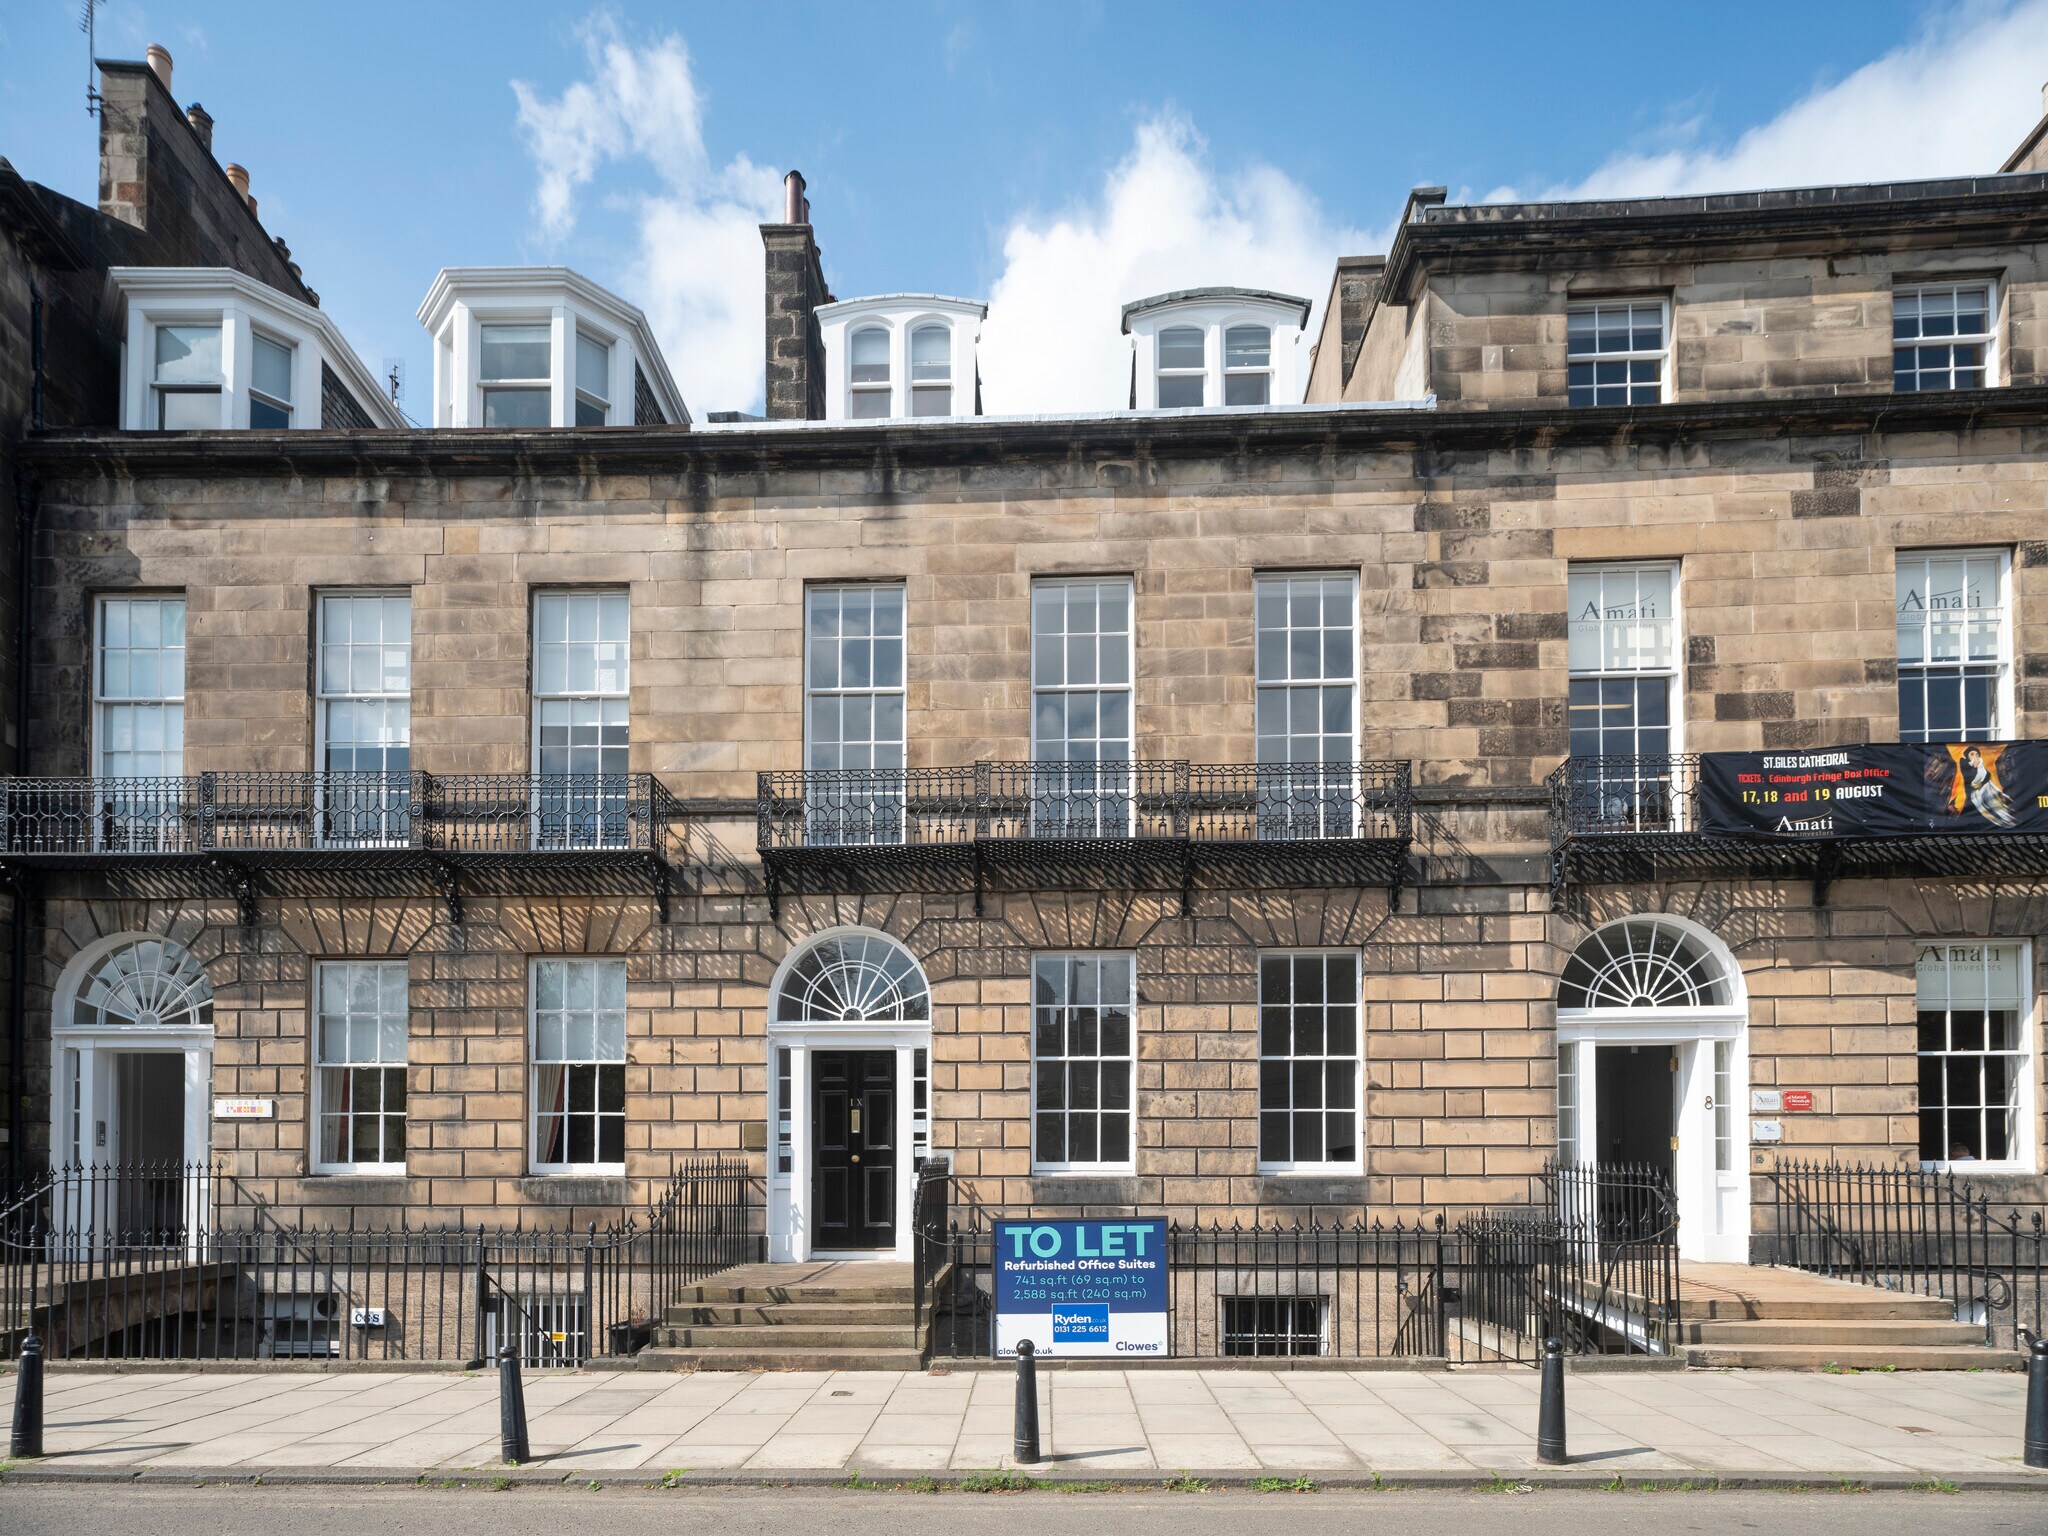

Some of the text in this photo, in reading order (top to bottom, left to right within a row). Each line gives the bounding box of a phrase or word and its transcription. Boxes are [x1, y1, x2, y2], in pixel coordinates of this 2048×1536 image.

[1901, 589, 1981, 610] Amati
[1581, 601, 1655, 620] Amati
[1578, 623, 1609, 632] Globl
[1799, 752, 1850, 768] CATHEDRAL
[1769, 773, 1812, 784] Edinburgh
[1813, 771, 1842, 782] Fringe
[1844, 770, 1862, 779] Box
[1863, 769, 1889, 777] Office
[1784, 790, 1808, 802] and
[1814, 788, 1831, 801] 19
[1836, 785, 1884, 800] AUGUST
[1775, 815, 1833, 831] Amati
[1704, 1095, 1713, 1110] 8
[1004, 1225, 1154, 1258] TO LET
[1004, 1259, 1156, 1271] Refurbished Office Suites
[1014, 1274, 1145, 1287] 741 sq.ft (69 sq.m) to
[1013, 1288, 1147, 1301] 2,588 sq.ft (240 sq.m)
[997, 1347, 1053, 1355] clowo.uk
[1115, 1341, 1158, 1351] Clowes
